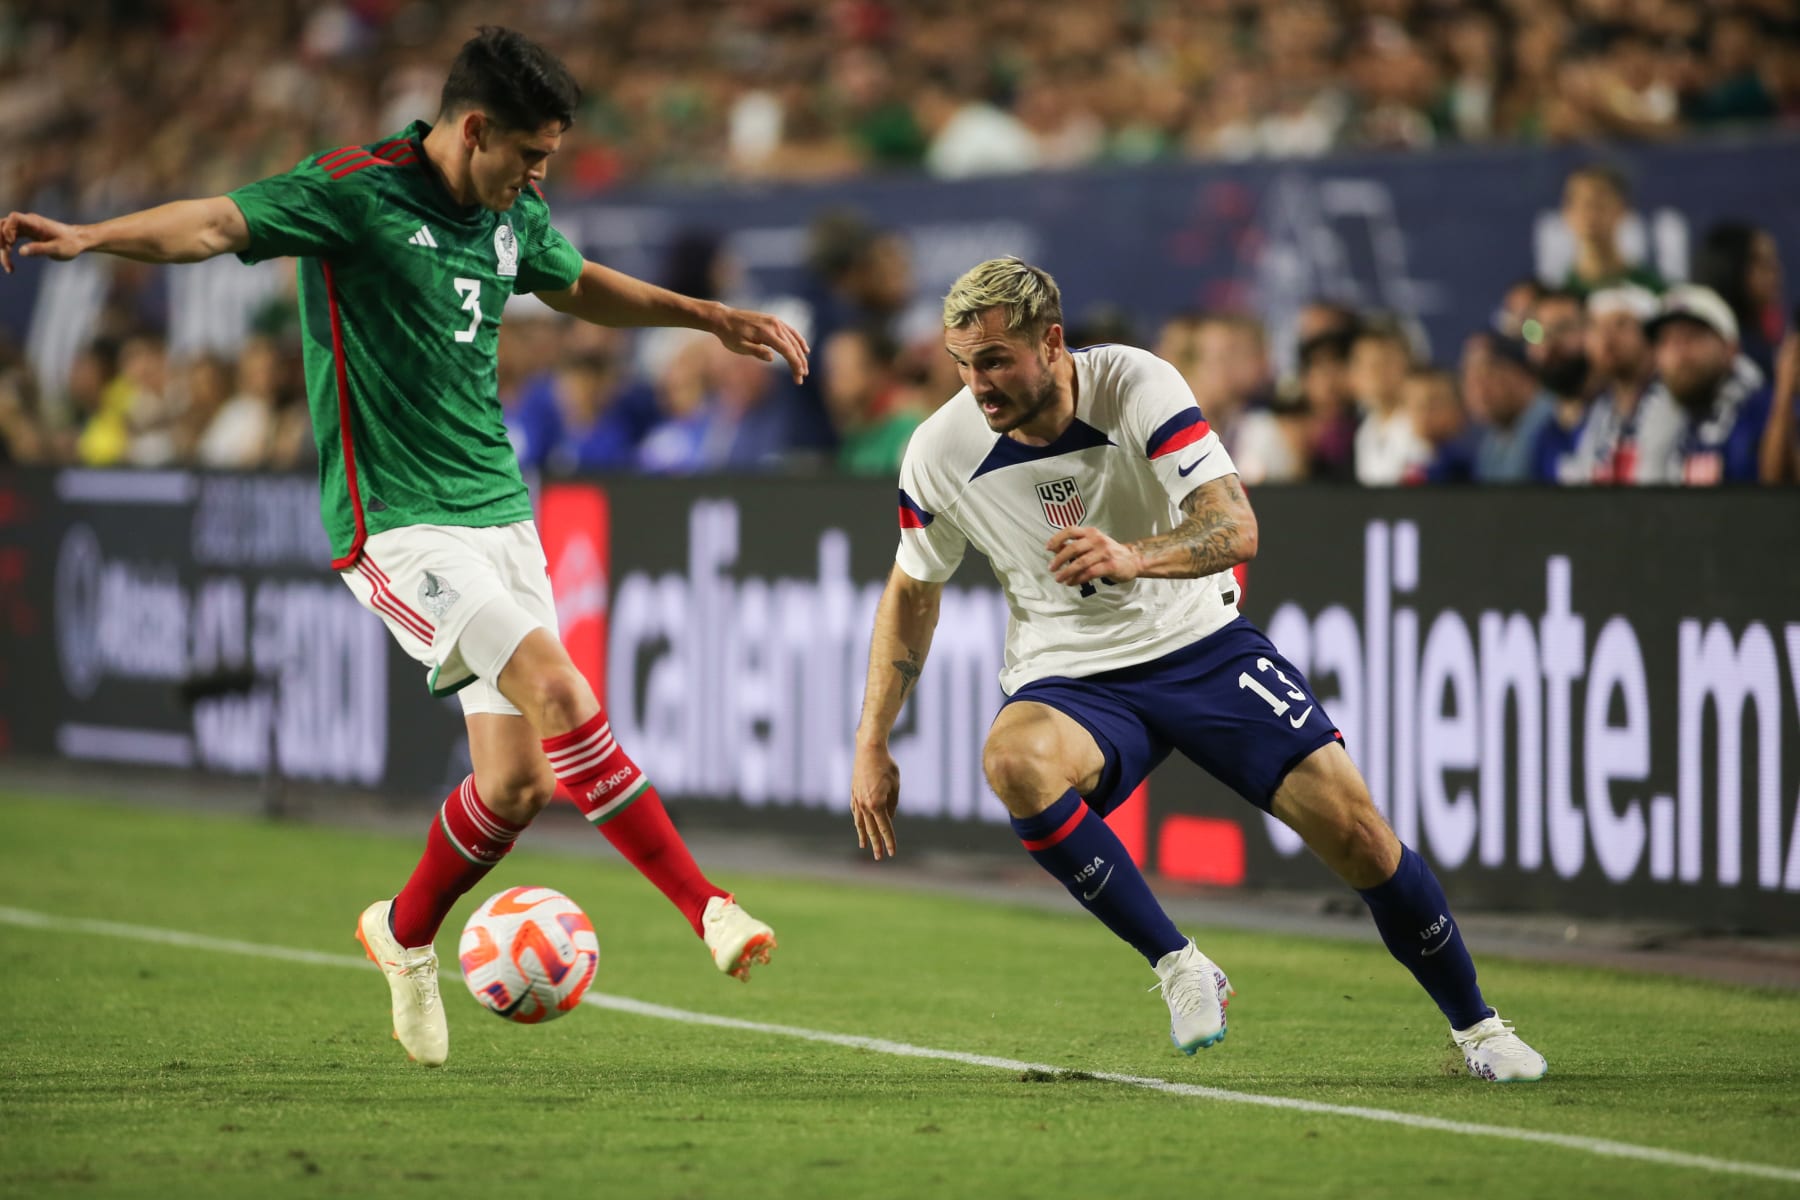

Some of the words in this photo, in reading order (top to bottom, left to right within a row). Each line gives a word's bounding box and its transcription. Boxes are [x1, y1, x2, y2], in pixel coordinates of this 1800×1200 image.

[453, 276, 483, 343] 3
[1039, 479, 1076, 503] USA
[1238, 657, 1307, 718] 13
[1073, 855, 1105, 883] USA
[1419, 913, 1448, 940] USA
